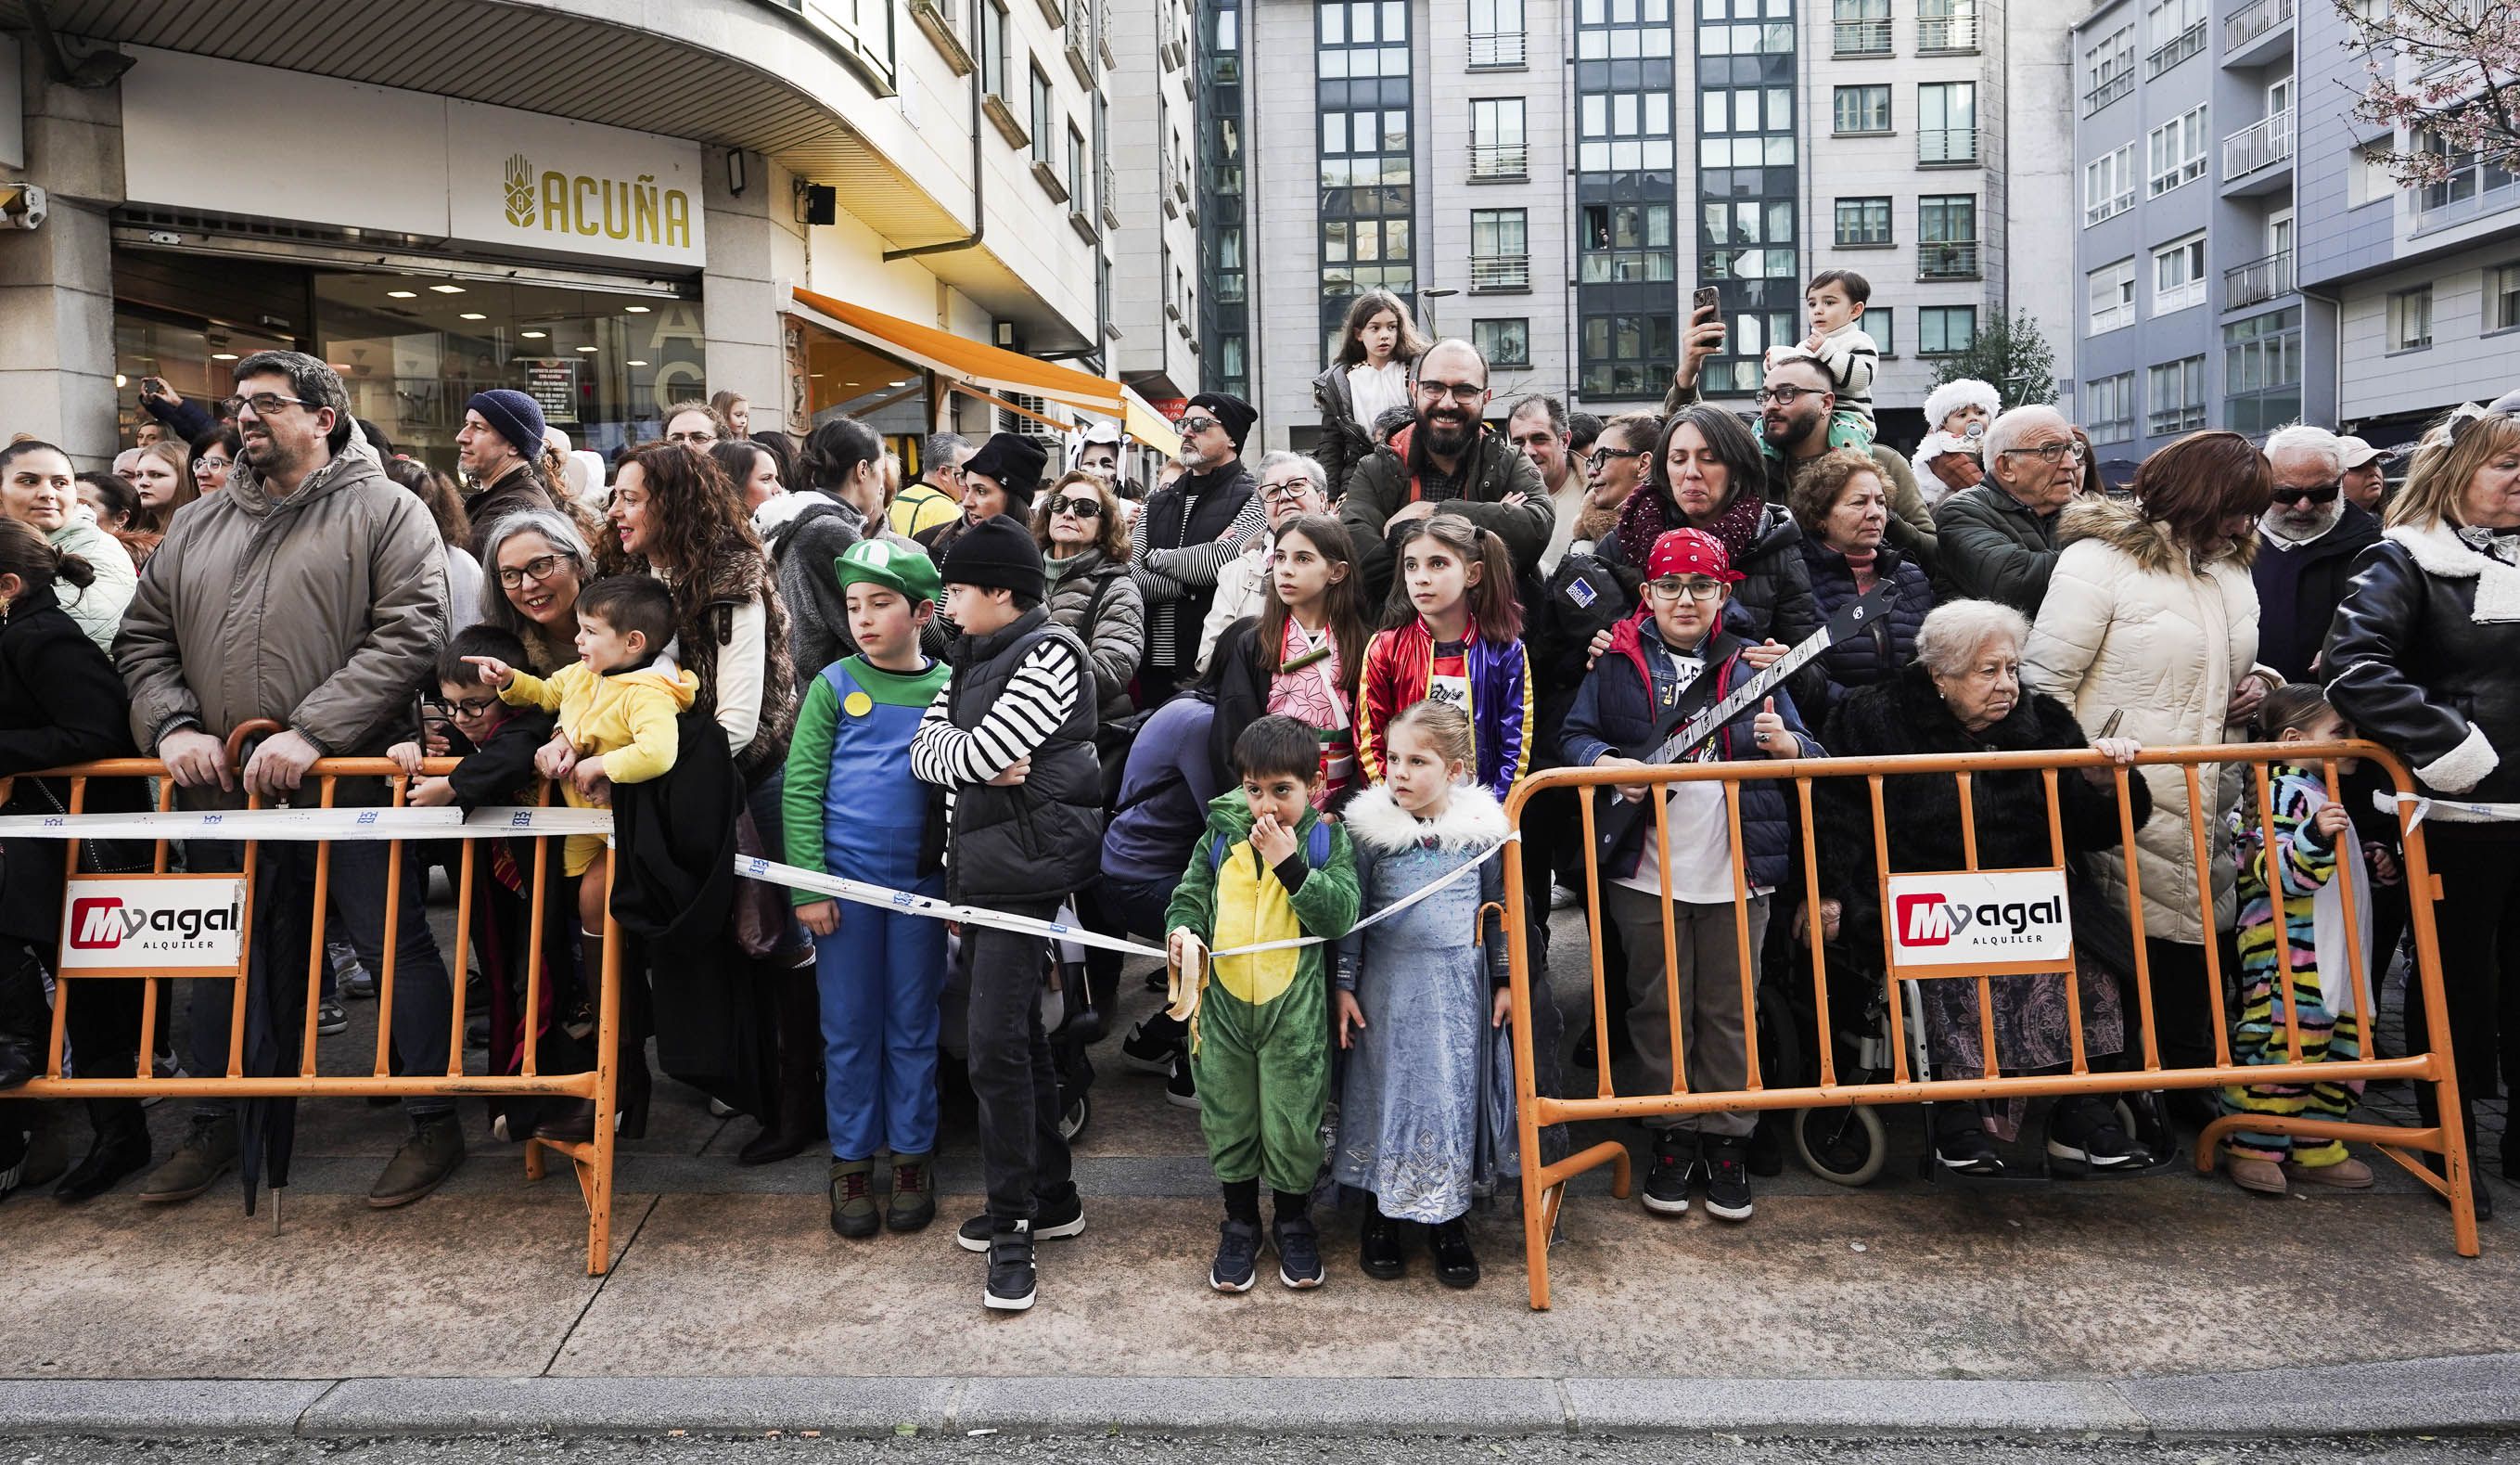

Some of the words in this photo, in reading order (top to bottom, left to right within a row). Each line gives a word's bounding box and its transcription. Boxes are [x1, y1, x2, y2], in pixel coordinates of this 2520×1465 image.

[542, 171, 690, 248] ACUÑA
[78, 902, 238, 941] Myagal
[1907, 895, 2062, 939] Myagal
[143, 941, 214, 950] ALQUILER
[1973, 934, 2043, 945] ALQUILER
